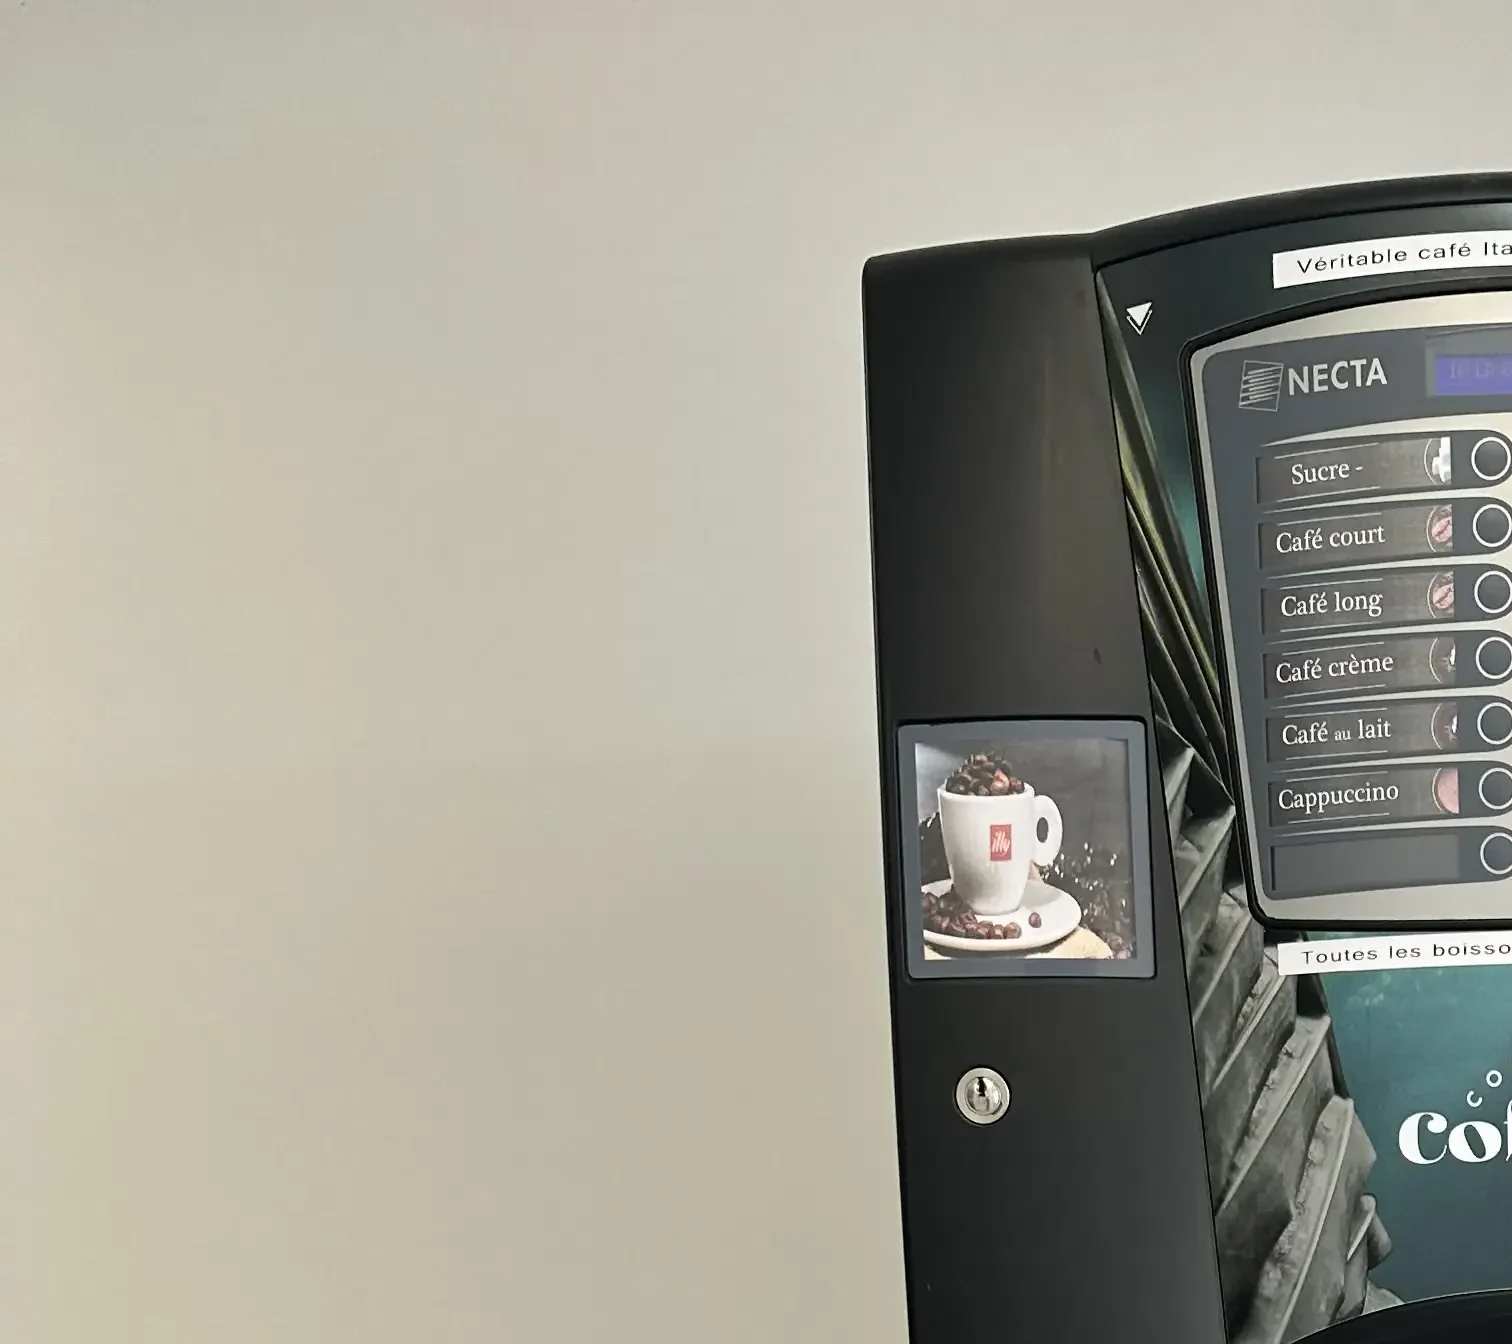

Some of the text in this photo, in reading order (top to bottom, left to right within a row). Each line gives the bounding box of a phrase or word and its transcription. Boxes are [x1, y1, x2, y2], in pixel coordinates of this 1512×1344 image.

[1296, 247, 1407, 274] Véritable
[1417, 241, 1471, 261] café
[1288, 358, 1388, 396] NECTA
[1291, 460, 1349, 485] Sucre
[1276, 523, 1386, 555] Café court
[1280, 588, 1383, 619] Café long
[1276, 651, 1394, 685] Café crème
[1281, 716, 1391, 746] Café au lait
[1278, 781, 1399, 813] Cappuccino
[1302, 945, 1380, 966] Toutes
[1388, 943, 1422, 961] les
